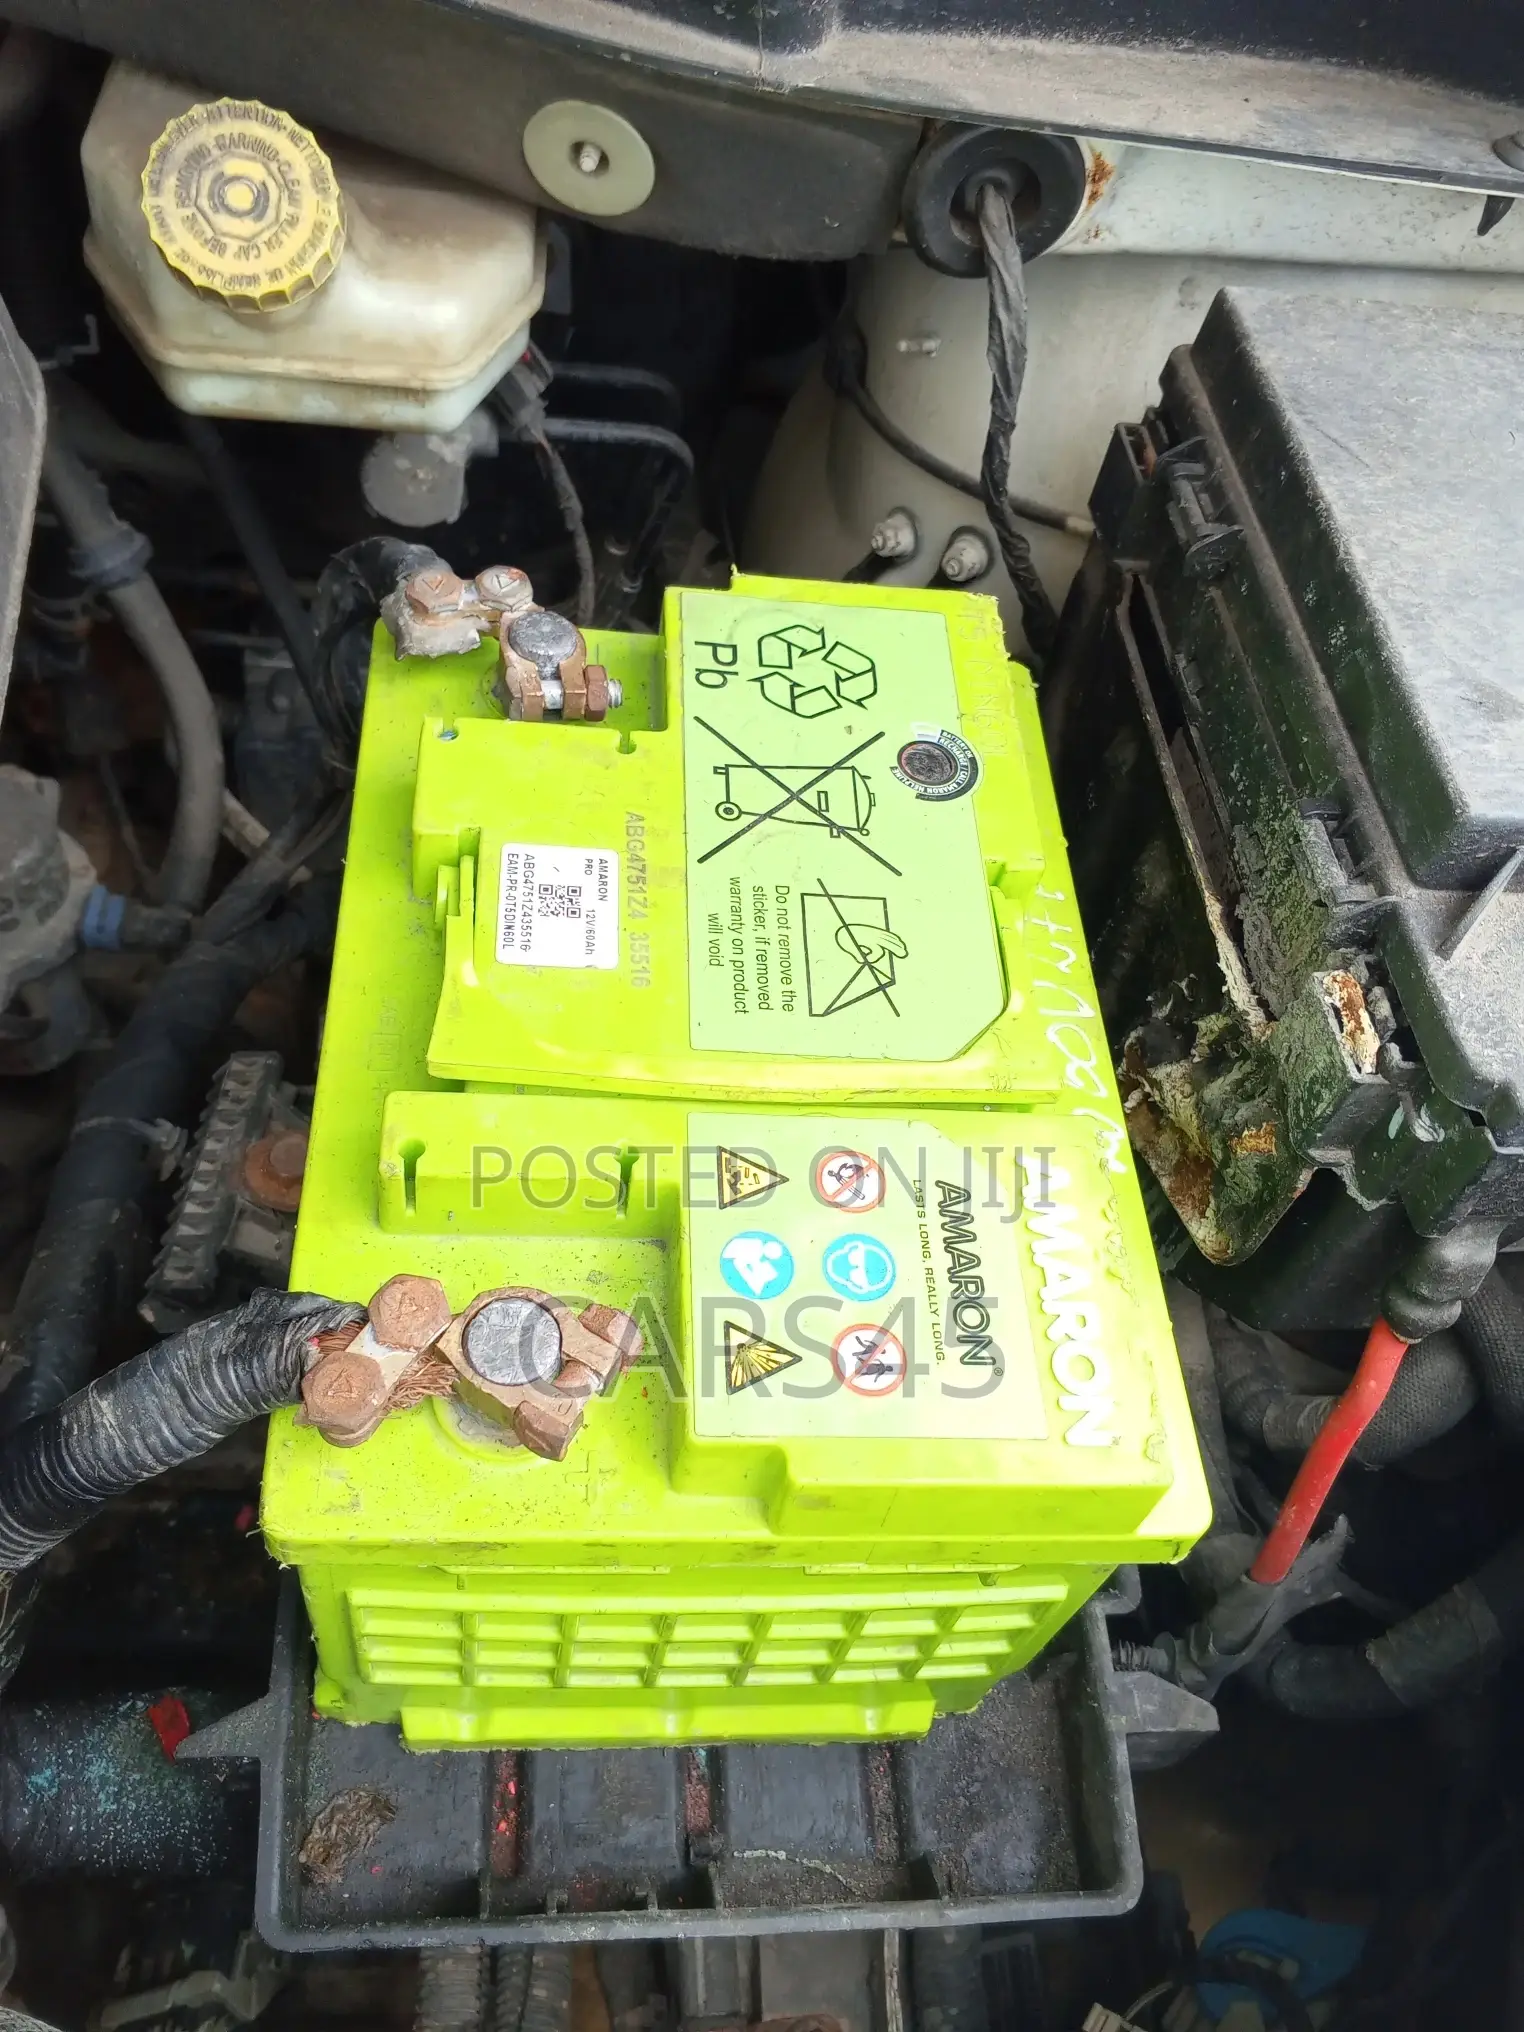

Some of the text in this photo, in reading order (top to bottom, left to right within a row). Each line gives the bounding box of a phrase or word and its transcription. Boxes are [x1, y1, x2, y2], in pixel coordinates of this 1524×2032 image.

[694, 640, 739, 689] Pb
[938, 738, 967, 767] RECHARGE
[954, 770, 968, 787] CALL
[942, 731, 974, 759] BATTERY OK
[520, 853, 535, 952] ABG4751Z435516
[585, 858, 596, 955] PRO 12V/60Ah
[598, 858, 608, 902] AMARON
[625, 811, 651, 988] ABG4751Z4 35516
[707, 912, 725, 967] will void
[727, 876, 750, 1014] warranty on product
[752, 885, 774, 1011] sticker, if removed
[775, 885, 798, 1012] Do not remove the
[912, 1179, 945, 1365] LASTS LONG, REALLY LONG.
[1015, 1155, 1113, 1447] AMARON
